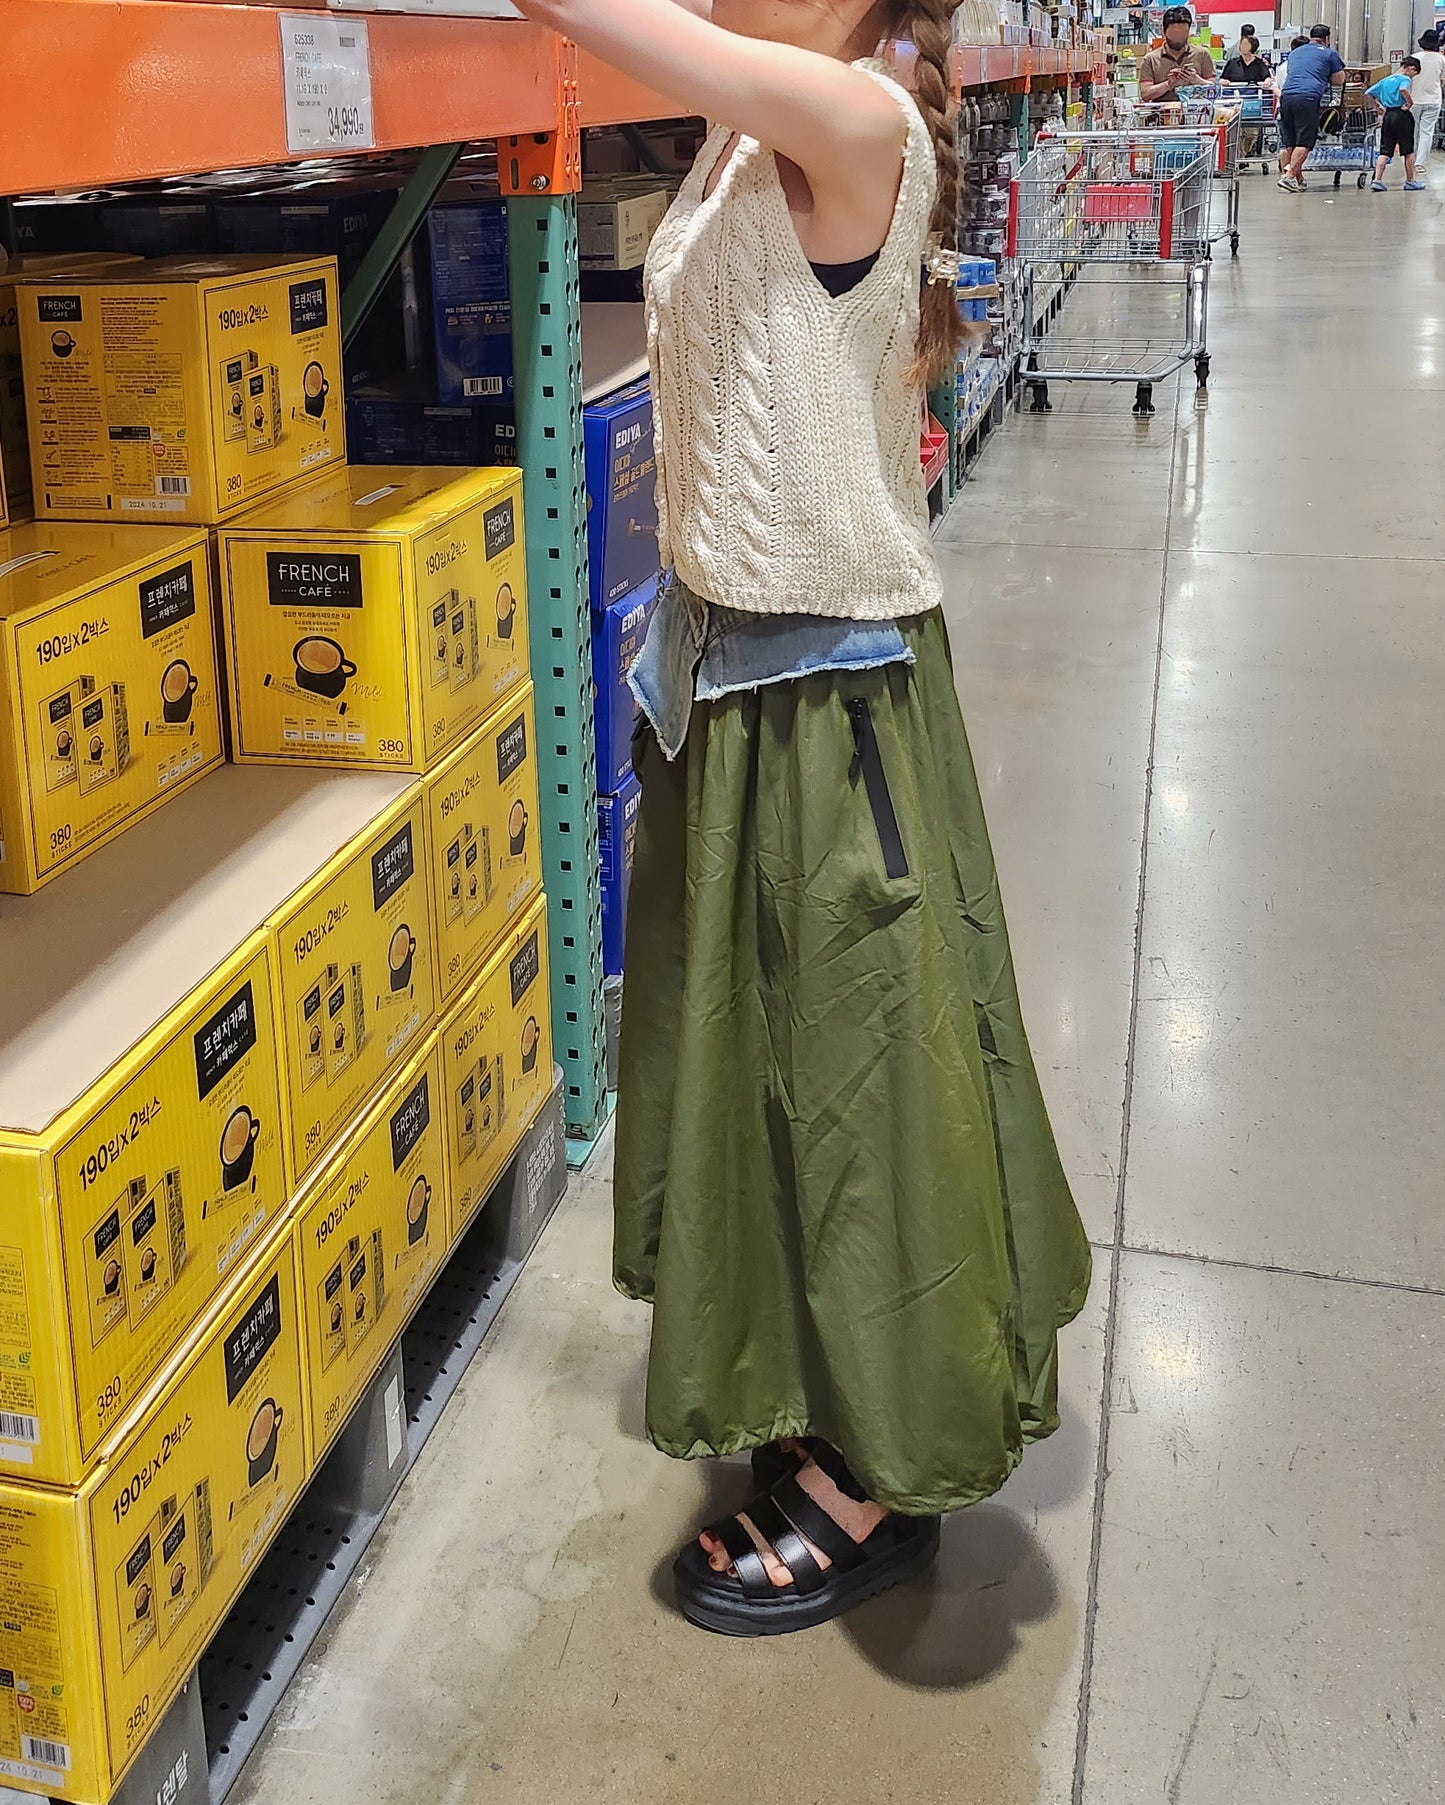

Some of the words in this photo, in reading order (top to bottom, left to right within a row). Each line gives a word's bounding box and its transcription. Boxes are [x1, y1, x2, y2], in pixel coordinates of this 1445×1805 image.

[294, 33, 314, 46] 625338
[43, 301, 77, 310] FRENCH
[615, 422, 641, 450] EDIYA
[226, 474, 242, 493] 380
[487, 509, 511, 537] FRENCH
[278, 563, 350, 583] FRENCH
[147, 574, 188, 609] 프렌치카페
[298, 583, 332, 598] CAFÉ
[158, 603, 179, 620] 카페믹스
[620, 603, 646, 635] EDIYA
[36, 617, 110, 666] 190입x2박스
[432, 717, 446, 739] 380
[378, 739, 404, 753] 380
[624, 787, 643, 821] EDIY
[50, 823, 72, 850] 380
[51, 840, 73, 859] STICKS
[377, 835, 408, 881] 프렌치카페
[293, 899, 350, 965] 190입x2박스
[447, 953, 460, 977] 380
[513, 941, 536, 983] FRENCH
[203, 999, 248, 1061] 프렌치카페
[216, 1039, 239, 1068] 카페믹스
[395, 1088, 425, 1142] FRENCH
[79, 1096, 163, 1192] 190입x2박스
[304, 1120, 321, 1150] 380
[404, 1118, 419, 1146] CAFÉ
[315, 1170, 370, 1250] 190입x2박스
[232, 1292, 274, 1364] 프렌치카페
[244, 1336, 265, 1368] 카페믹스
[96, 1375, 122, 1418] 380
[98, 1396, 122, 1429] STICKS
[324, 1395, 341, 1429] 380
[112, 1412, 193, 1525] 190입x2박스
[126, 1693, 150, 1739] 380
